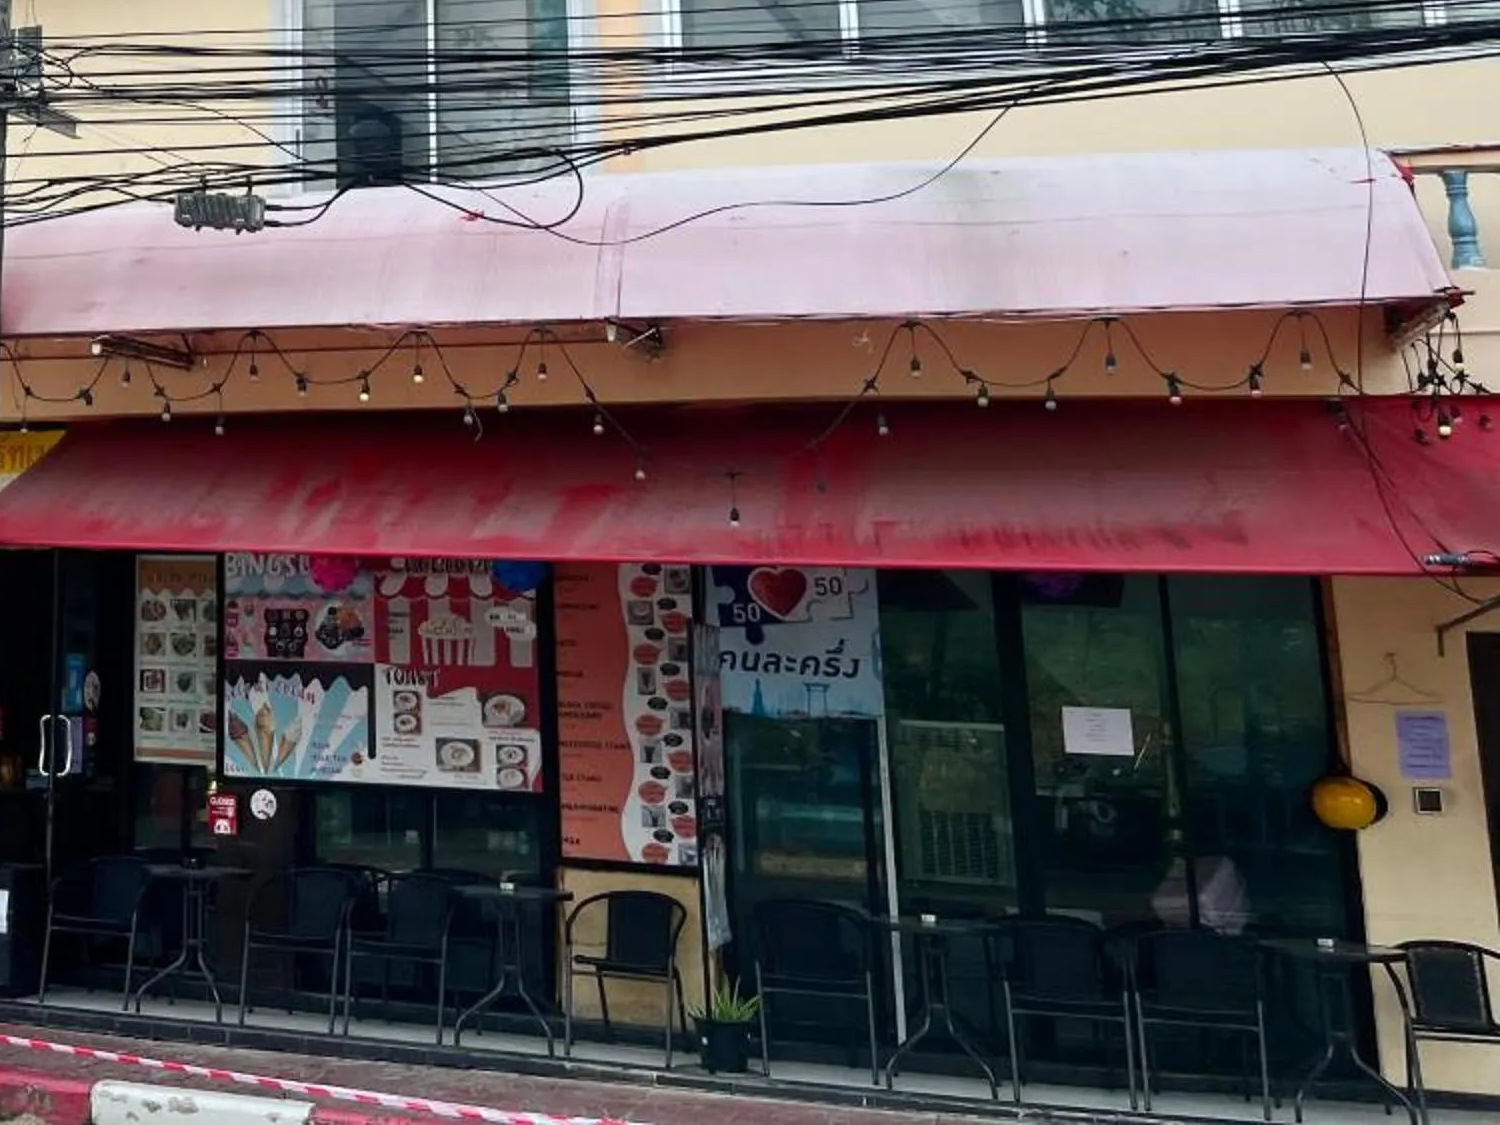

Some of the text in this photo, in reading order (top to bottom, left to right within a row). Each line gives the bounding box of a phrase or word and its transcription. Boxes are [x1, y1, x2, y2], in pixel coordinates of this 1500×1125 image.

[813, 576, 842, 596] 50
[732, 603, 761, 623] 50
[719, 639, 860, 679] คนละครึ่ง
